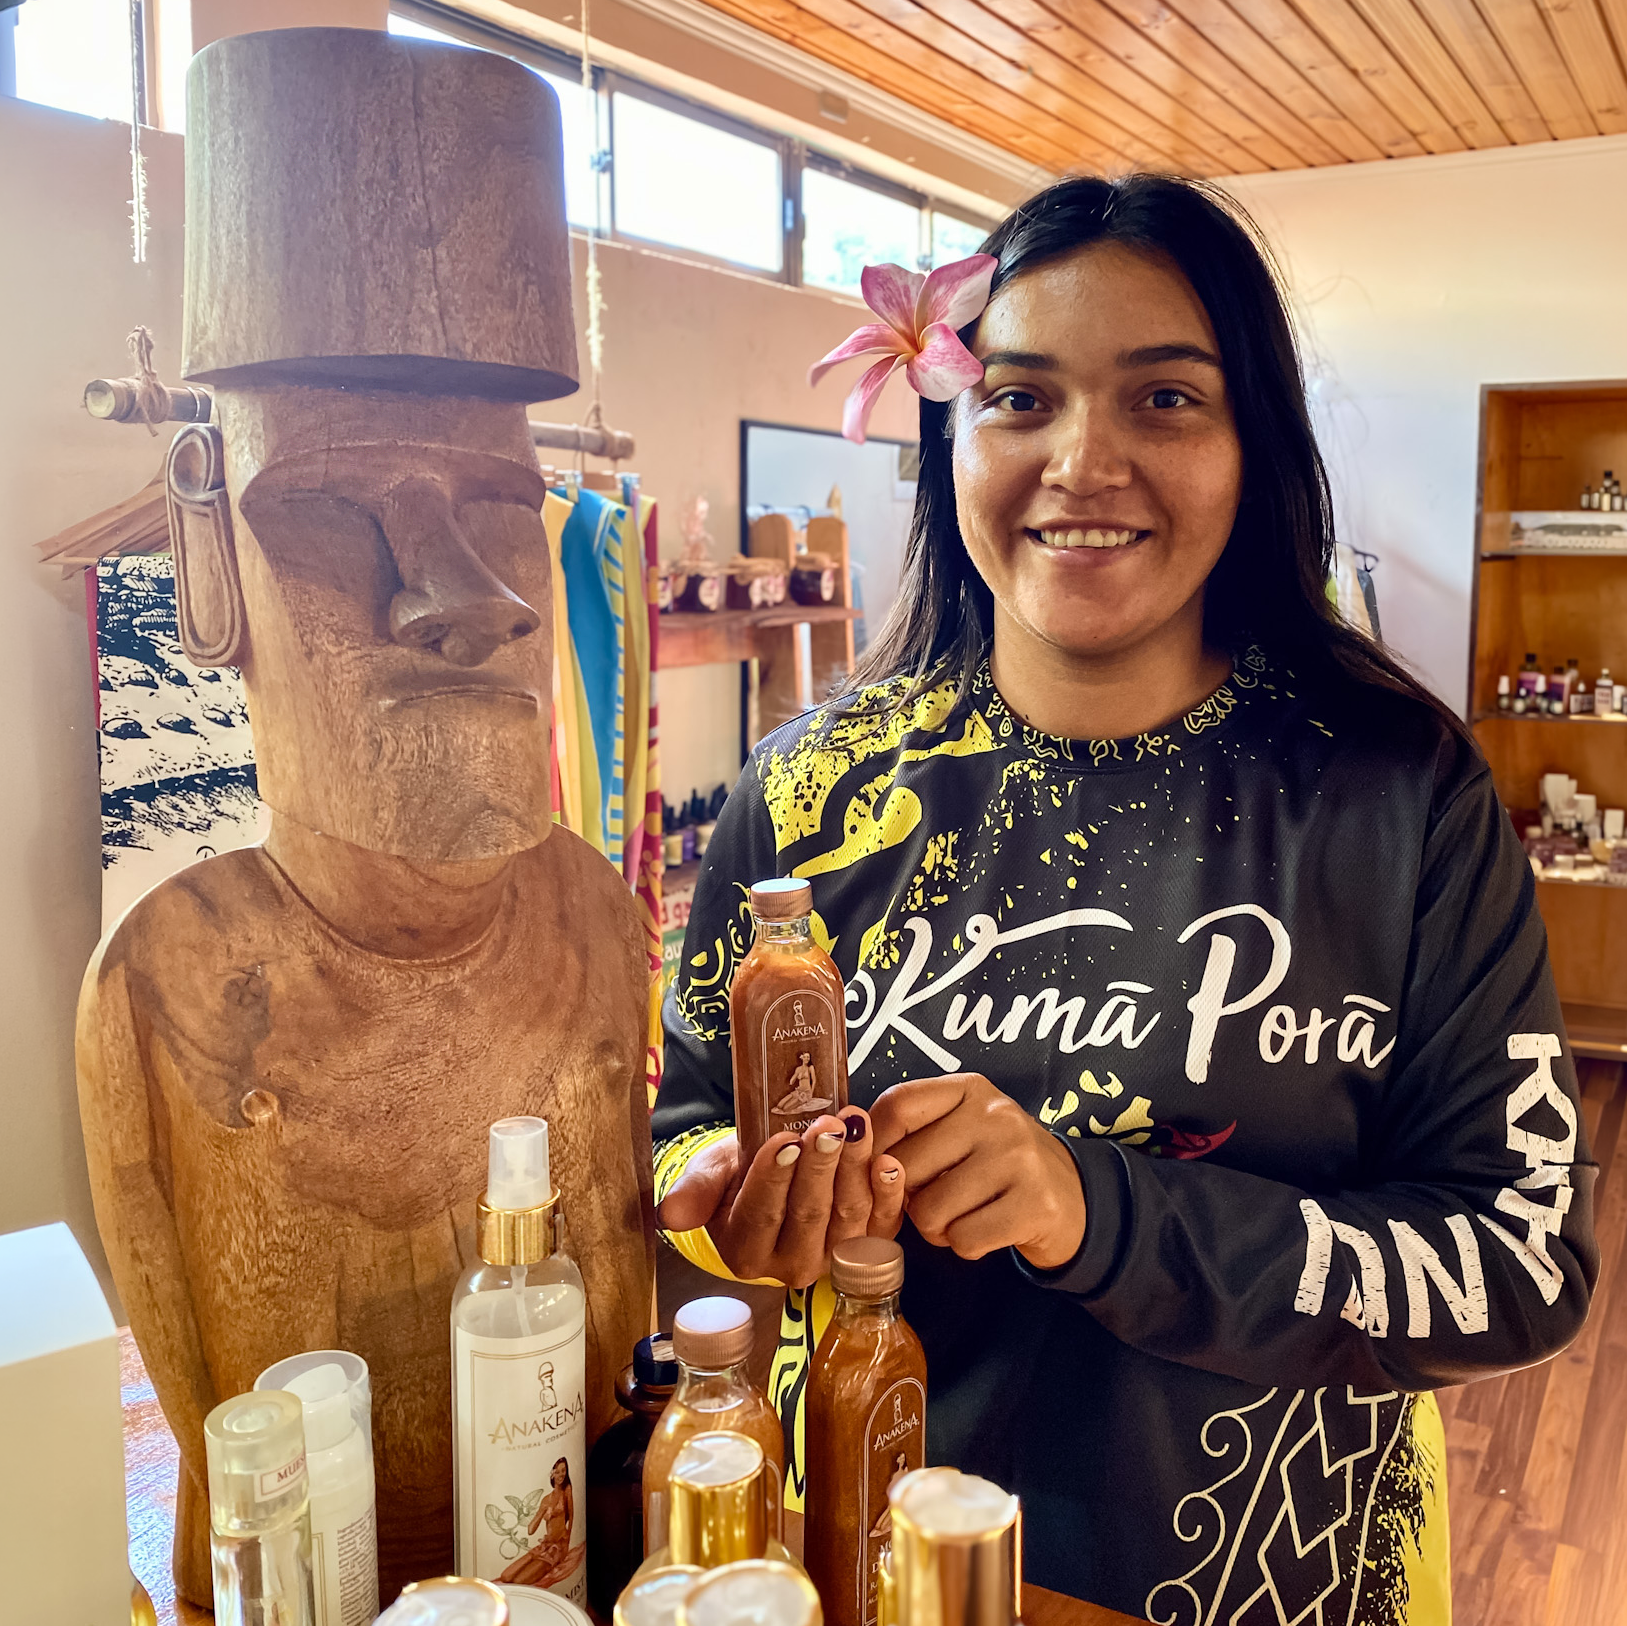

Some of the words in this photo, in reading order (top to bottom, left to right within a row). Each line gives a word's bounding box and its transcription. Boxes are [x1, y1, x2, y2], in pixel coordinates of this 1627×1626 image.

[771, 1021, 827, 1042] ANAKENA
[487, 1390, 584, 1445] ANAKENA
[872, 1412, 920, 1452] ANAKENA
